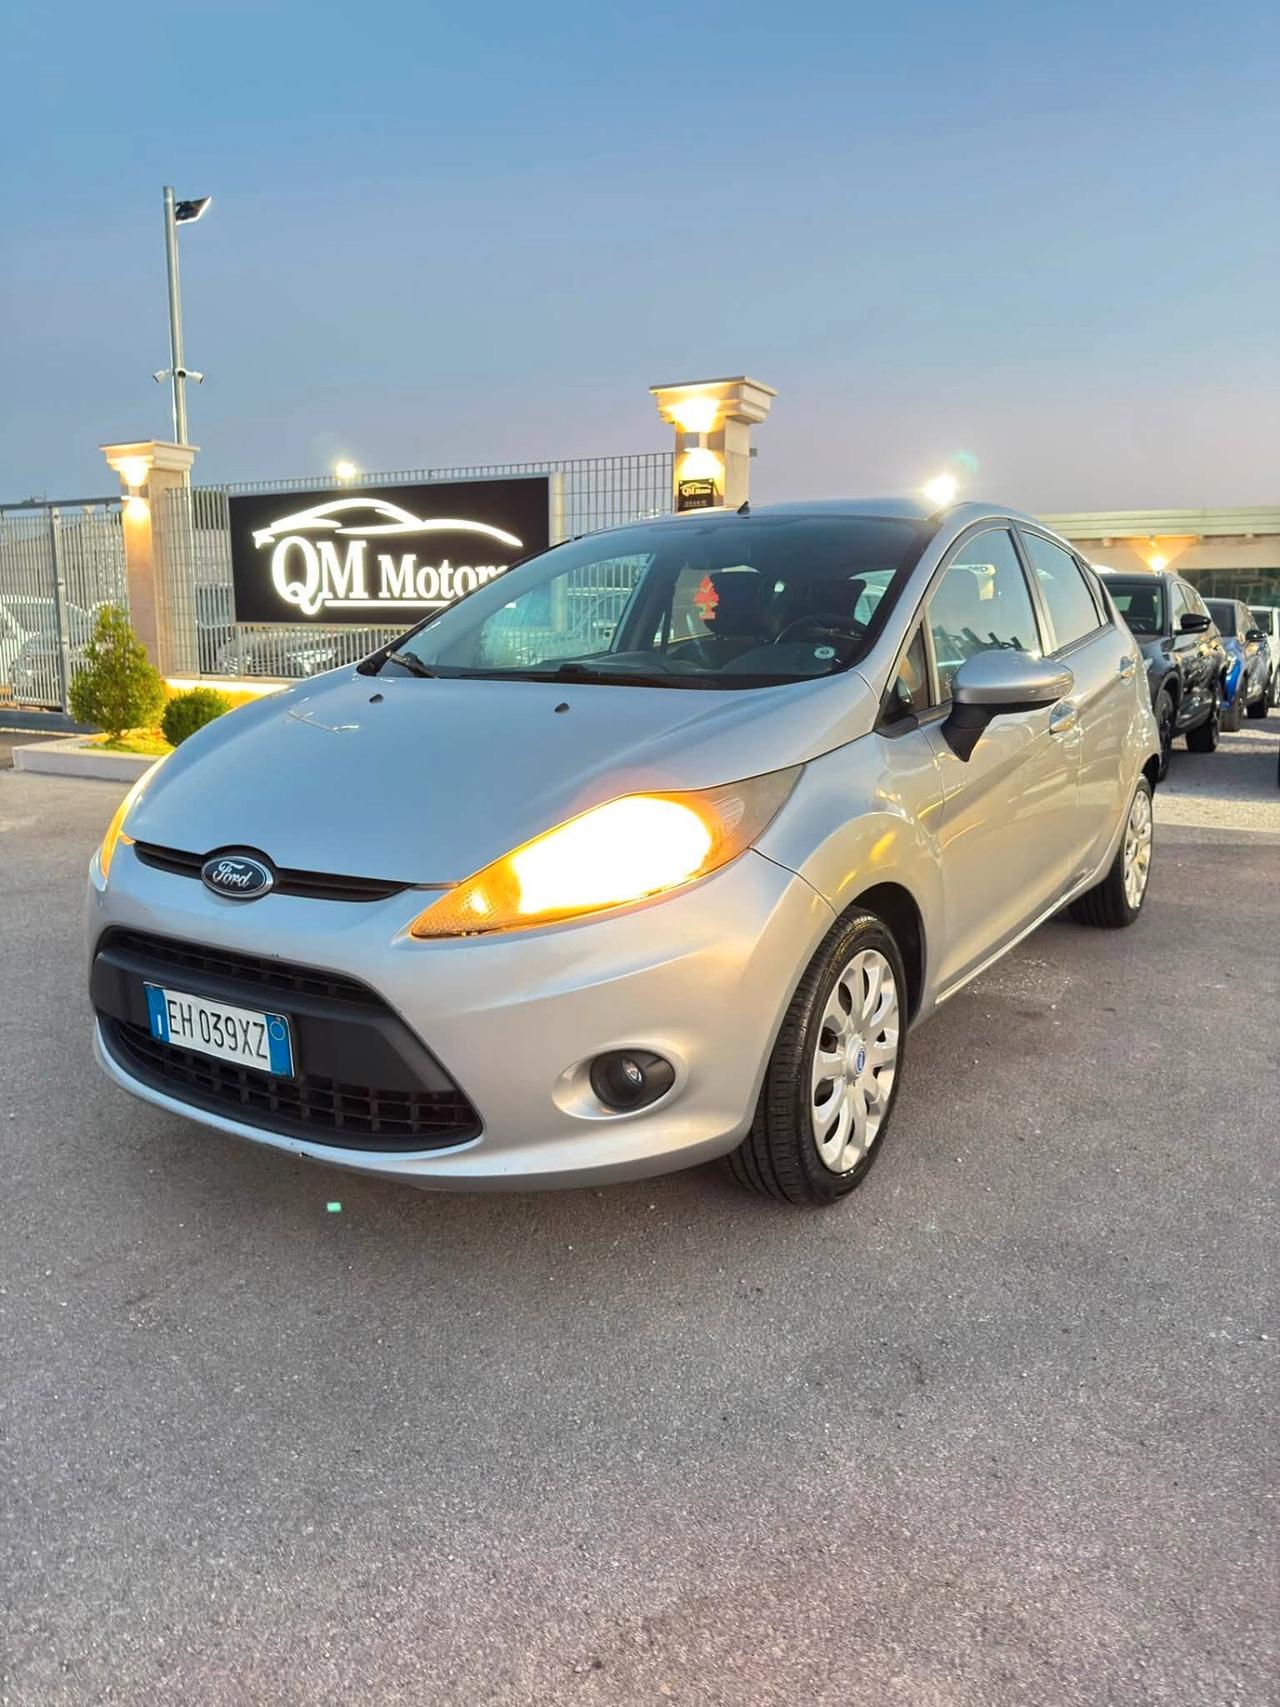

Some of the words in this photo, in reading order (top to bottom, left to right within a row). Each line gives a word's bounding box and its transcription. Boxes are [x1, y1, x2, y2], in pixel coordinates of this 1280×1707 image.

[271, 536, 368, 615] QM
[377, 554, 508, 600] Motor
[213, 861, 253, 888] Ford
